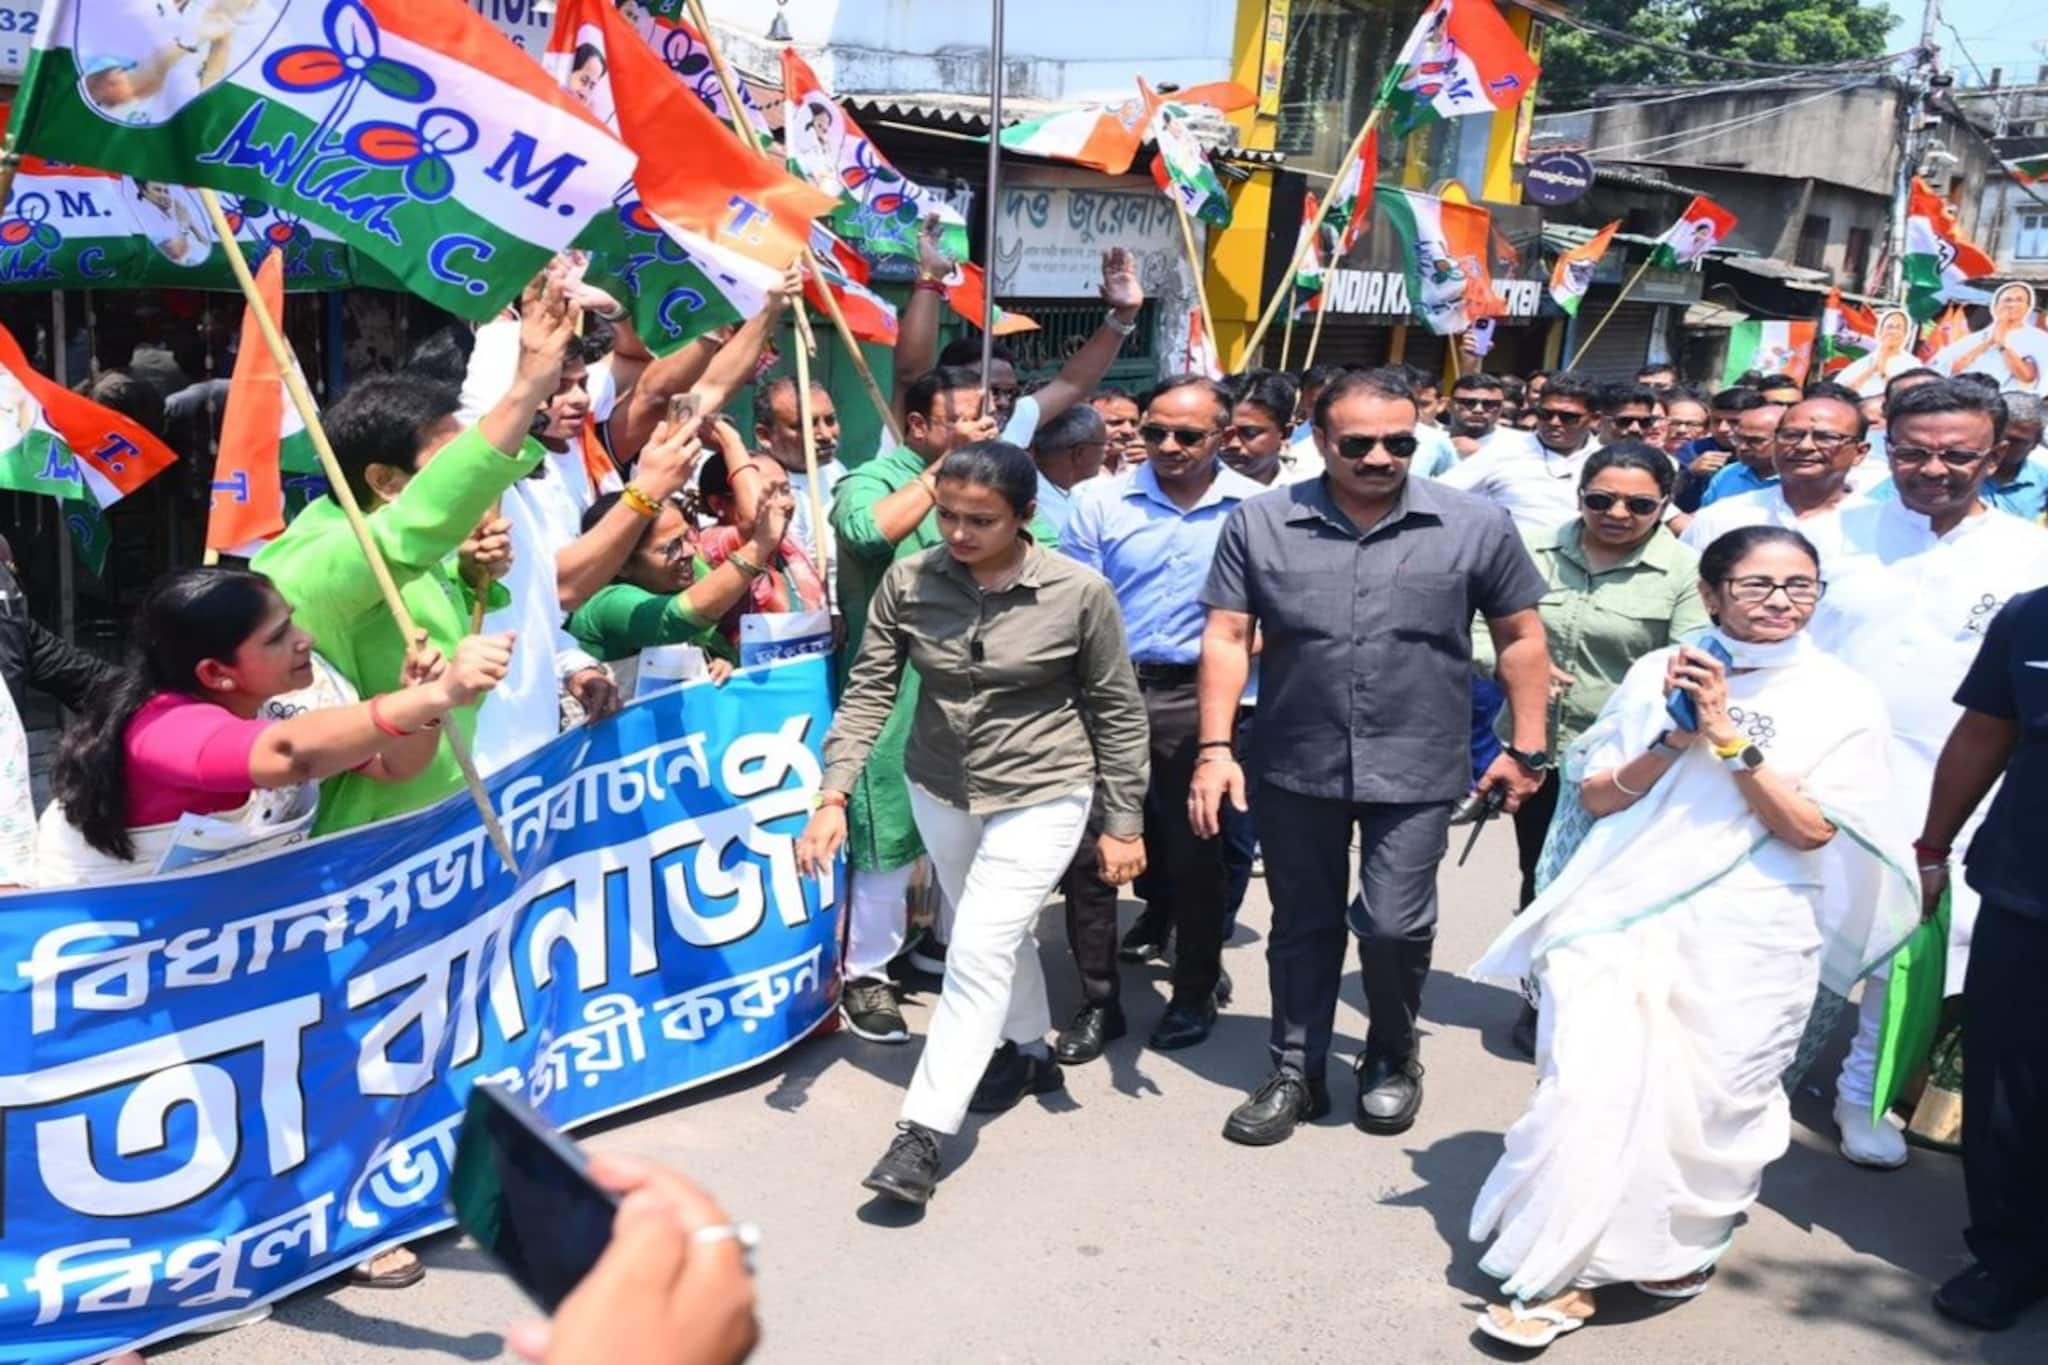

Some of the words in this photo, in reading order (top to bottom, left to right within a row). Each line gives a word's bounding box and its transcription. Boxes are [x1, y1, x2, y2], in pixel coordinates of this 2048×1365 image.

[55, 189, 112, 218] M.
[484, 130, 588, 217] M.
[426, 233, 498, 294] C.
[91, 432, 142, 474] T.
[17, 824, 488, 1036] বিধানসভা
[24, 1192, 336, 1326] বিপুল
[653, 944, 822, 1042] করুন
